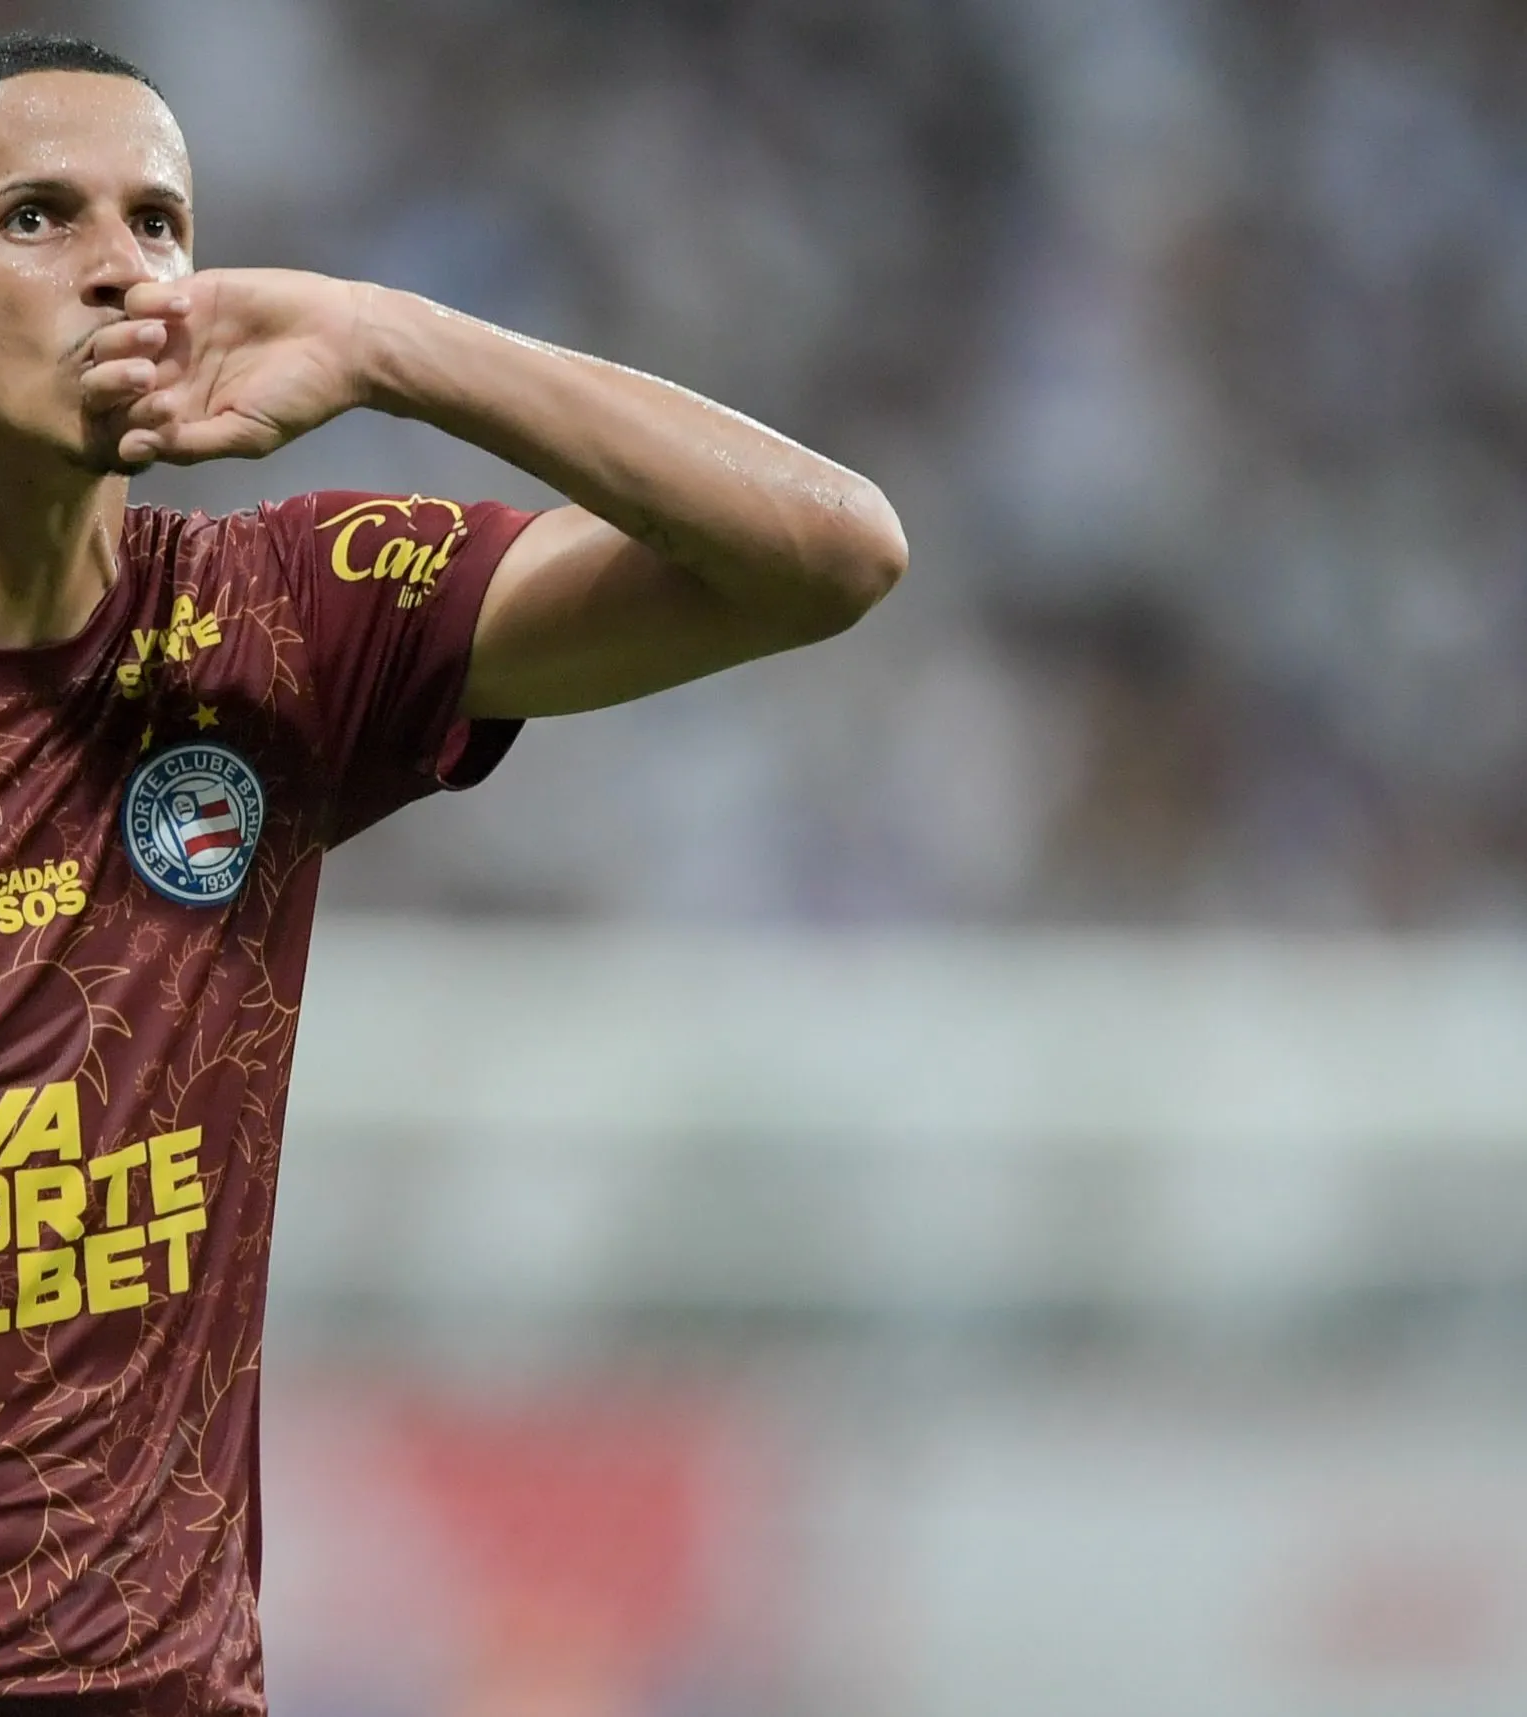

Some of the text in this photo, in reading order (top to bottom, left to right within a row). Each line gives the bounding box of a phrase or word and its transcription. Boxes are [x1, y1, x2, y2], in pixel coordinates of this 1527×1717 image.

[134, 752, 259, 877] ESPORTE CLUBE BAHIA
[199, 868, 235, 893] 1931
